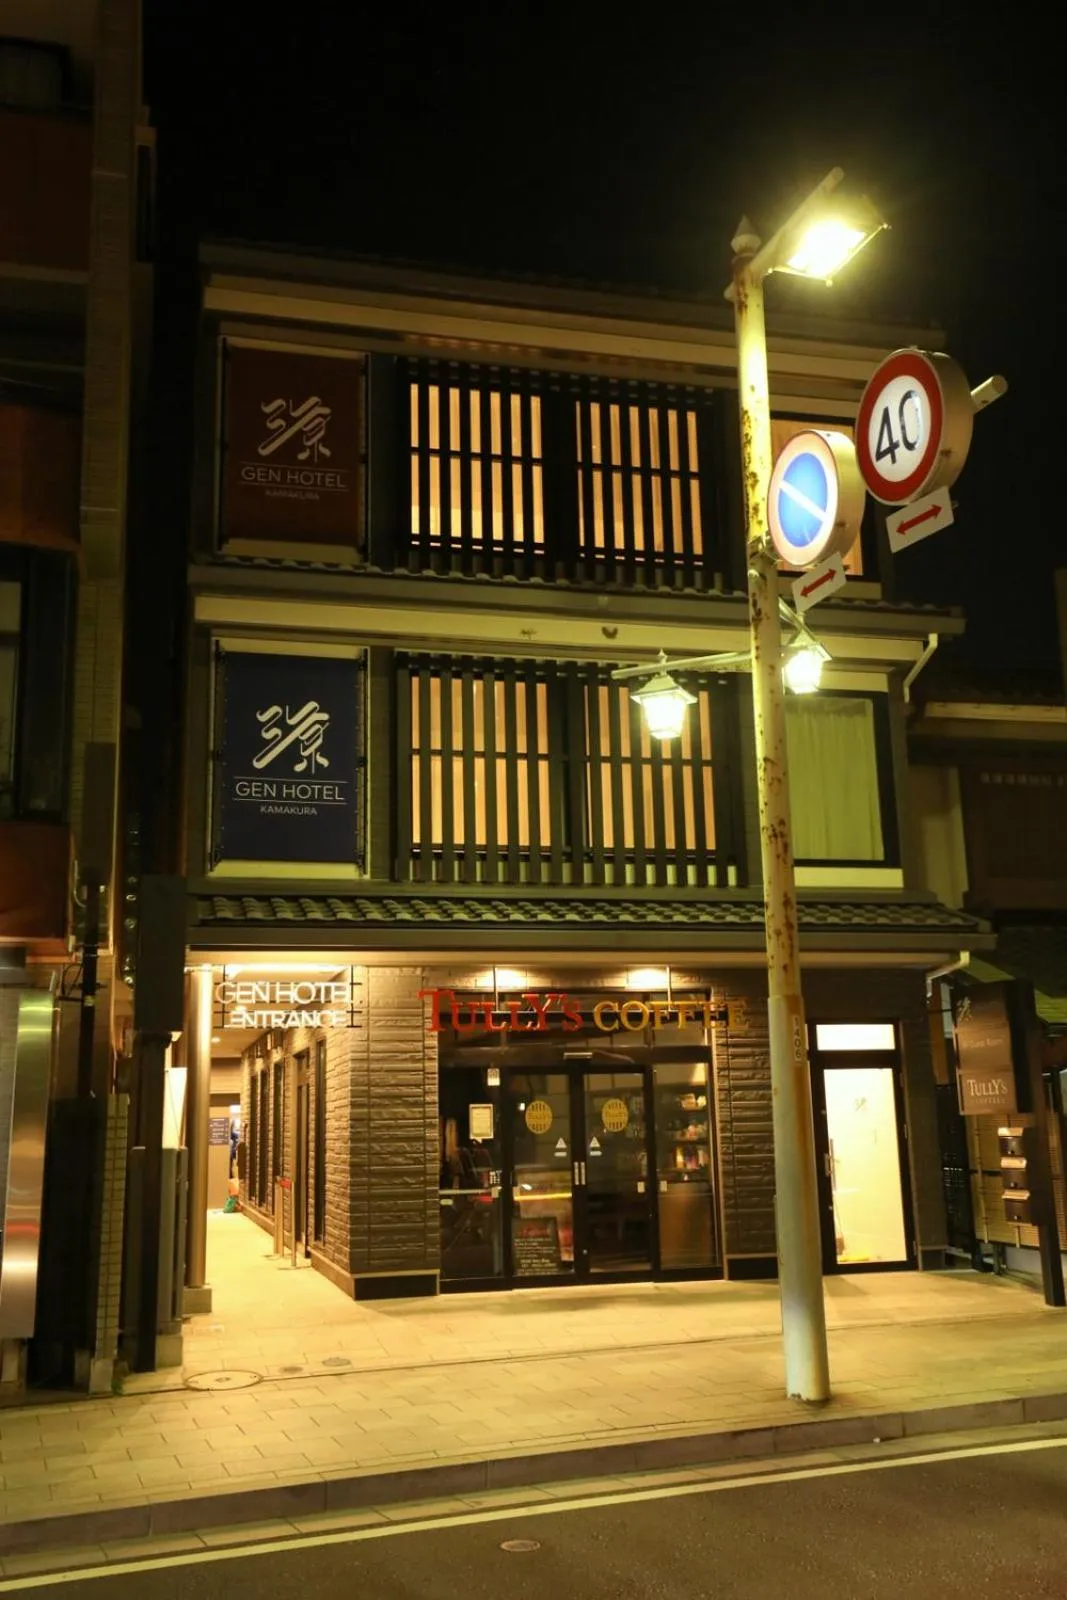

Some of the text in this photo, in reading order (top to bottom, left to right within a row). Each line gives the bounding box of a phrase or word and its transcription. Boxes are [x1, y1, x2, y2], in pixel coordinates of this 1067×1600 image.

[875, 390, 922, 464] 40
[241, 466, 347, 488] GEN HOTEL
[235, 781, 345, 800] GEN HOTEL
[260, 805, 318, 816] KAMAKURA
[215, 982, 271, 1004] GEN
[227, 1009, 346, 1028] ENTRANCE
[416, 988, 749, 1032] TULLY'S COFFEE
[966, 1078, 1008, 1097] TULLY'S
